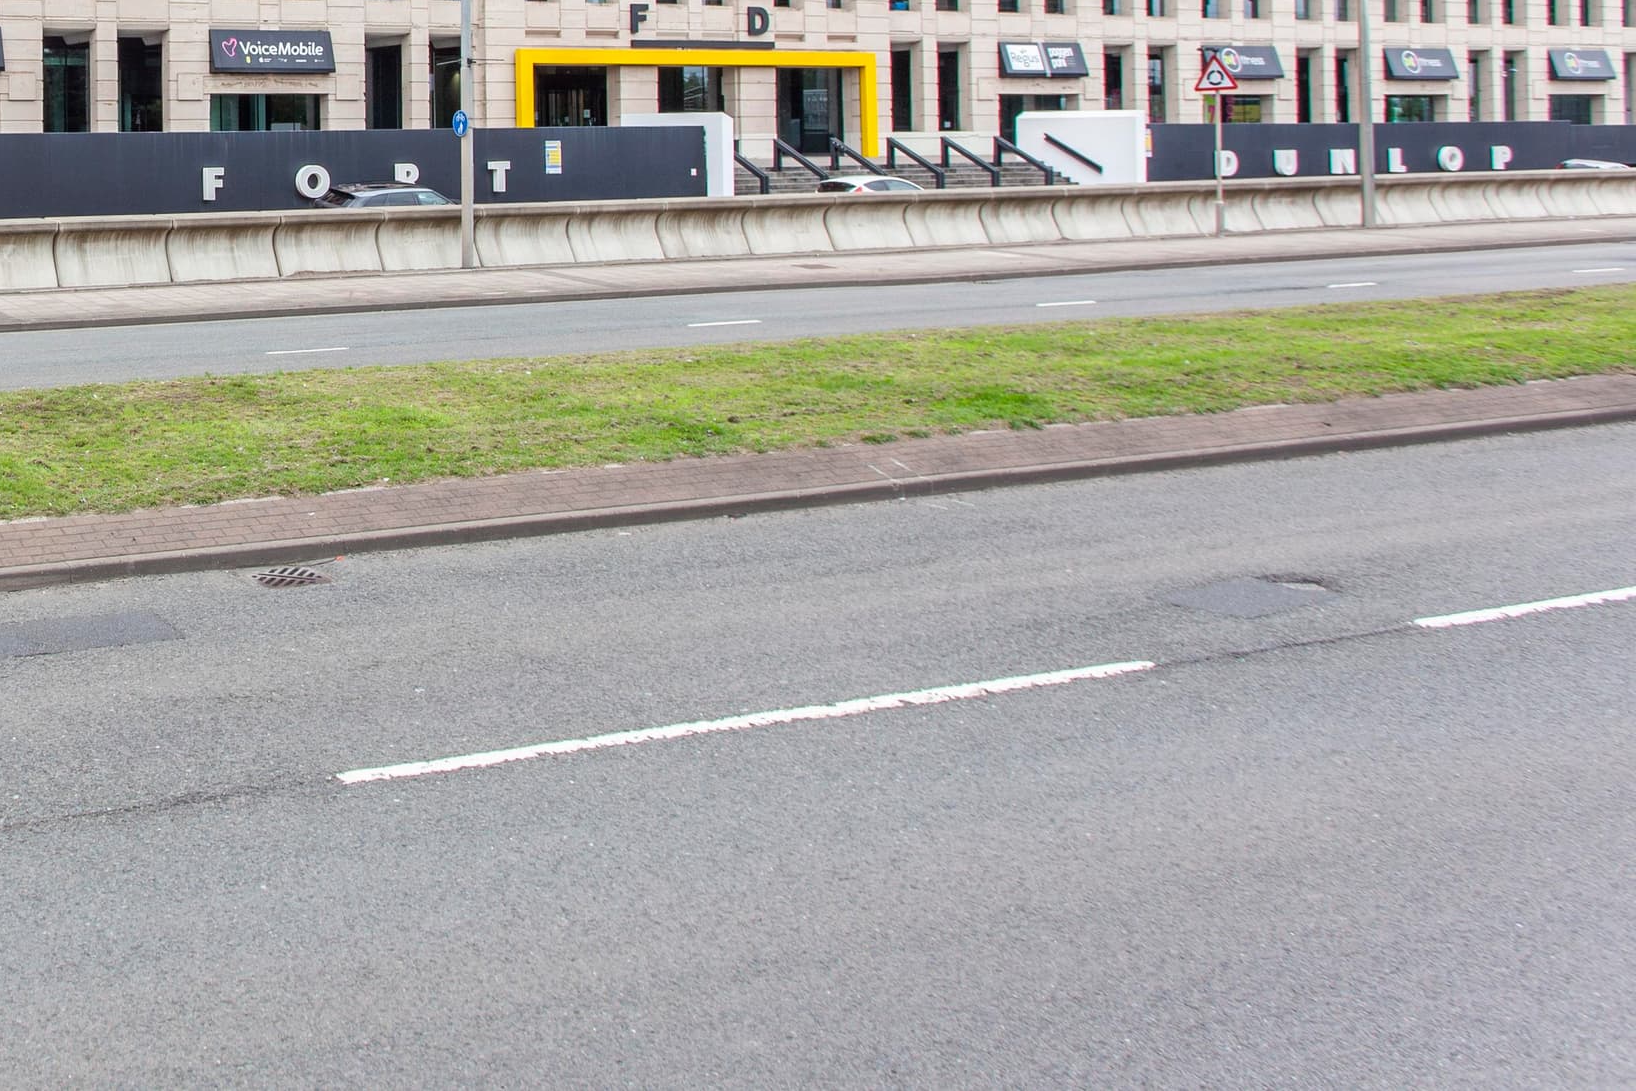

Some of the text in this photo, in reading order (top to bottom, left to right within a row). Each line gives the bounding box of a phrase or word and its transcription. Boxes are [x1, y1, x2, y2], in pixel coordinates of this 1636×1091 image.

[630, 3, 770, 36] F D
[1214, 145, 1513, 177] DUNLOP
